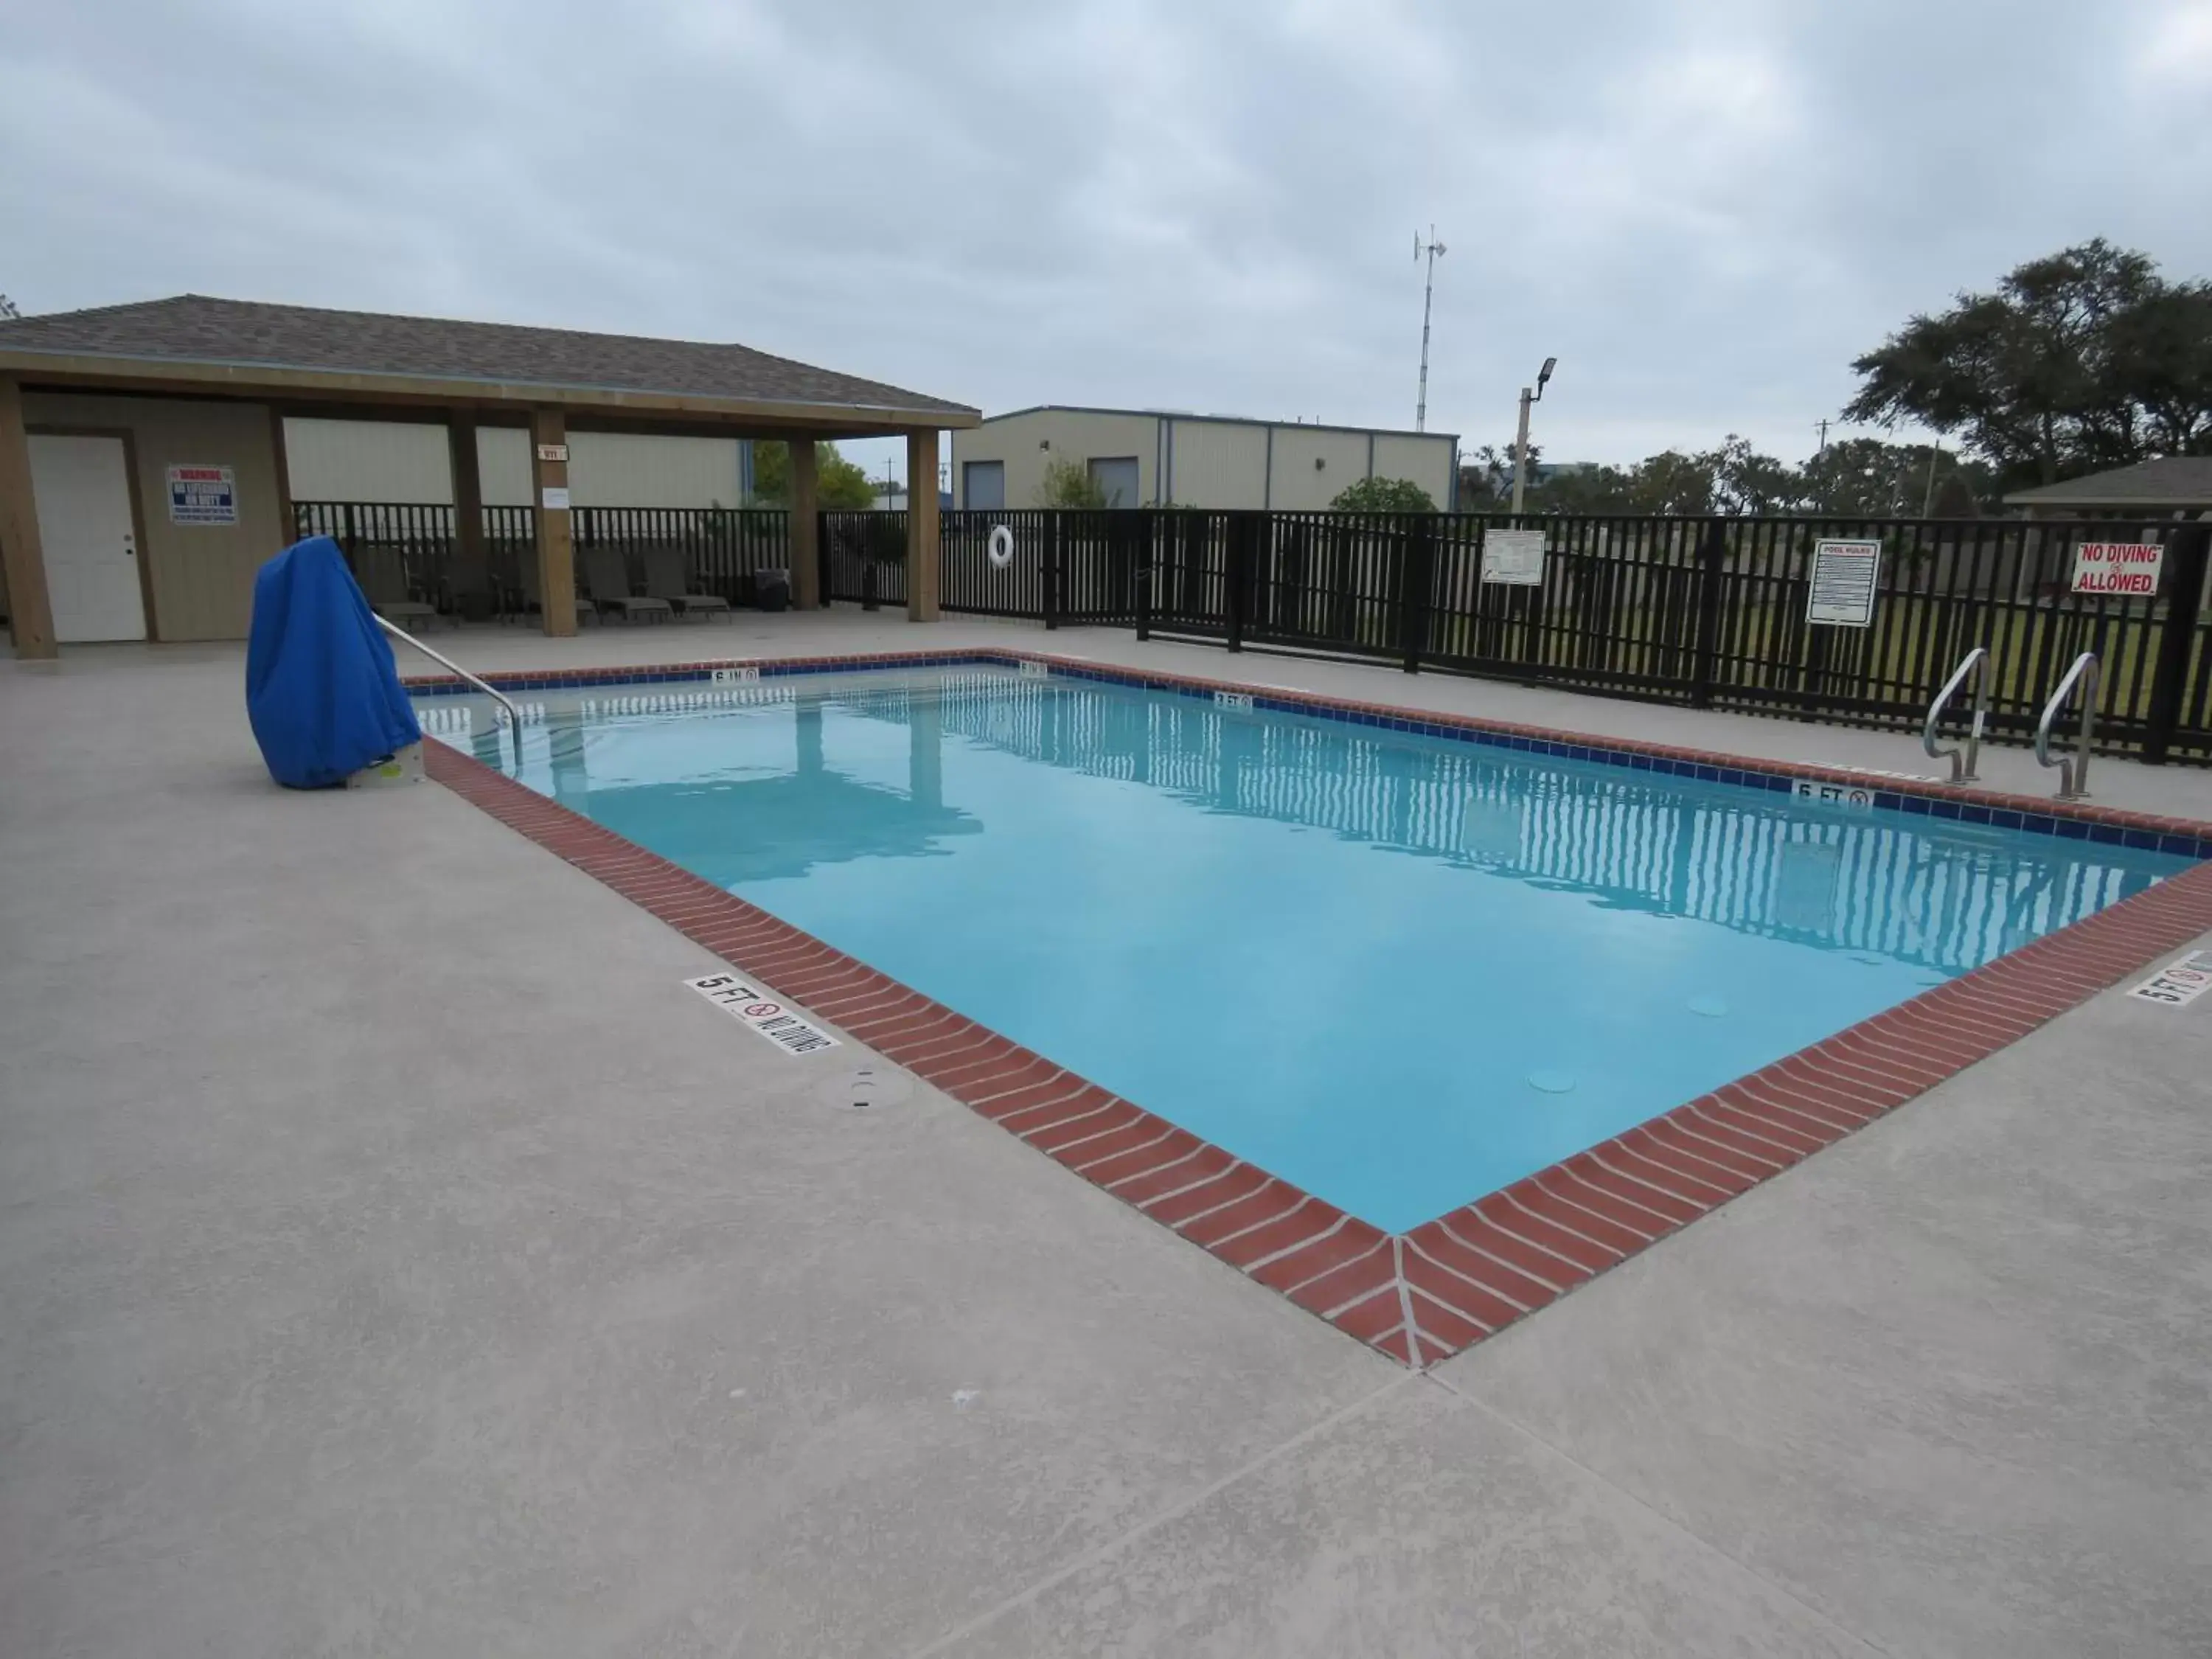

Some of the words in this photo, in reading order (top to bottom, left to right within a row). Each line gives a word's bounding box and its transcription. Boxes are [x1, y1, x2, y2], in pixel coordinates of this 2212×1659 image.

[187, 484, 229, 495] LIFEGUARD
[198, 495, 220, 506] DUTY
[2082, 544, 2104, 561] NO
[2107, 546, 2157, 563] DIVING
[2079, 572, 2152, 592] ALLOWED
[696, 977, 734, 989] 5
[2150, 977, 2198, 995] FT
[712, 987, 760, 1004] FT
[2138, 989, 2181, 1002] 5
[756, 1015, 797, 1030] NO
[771, 1026, 832, 1052] DIVING
